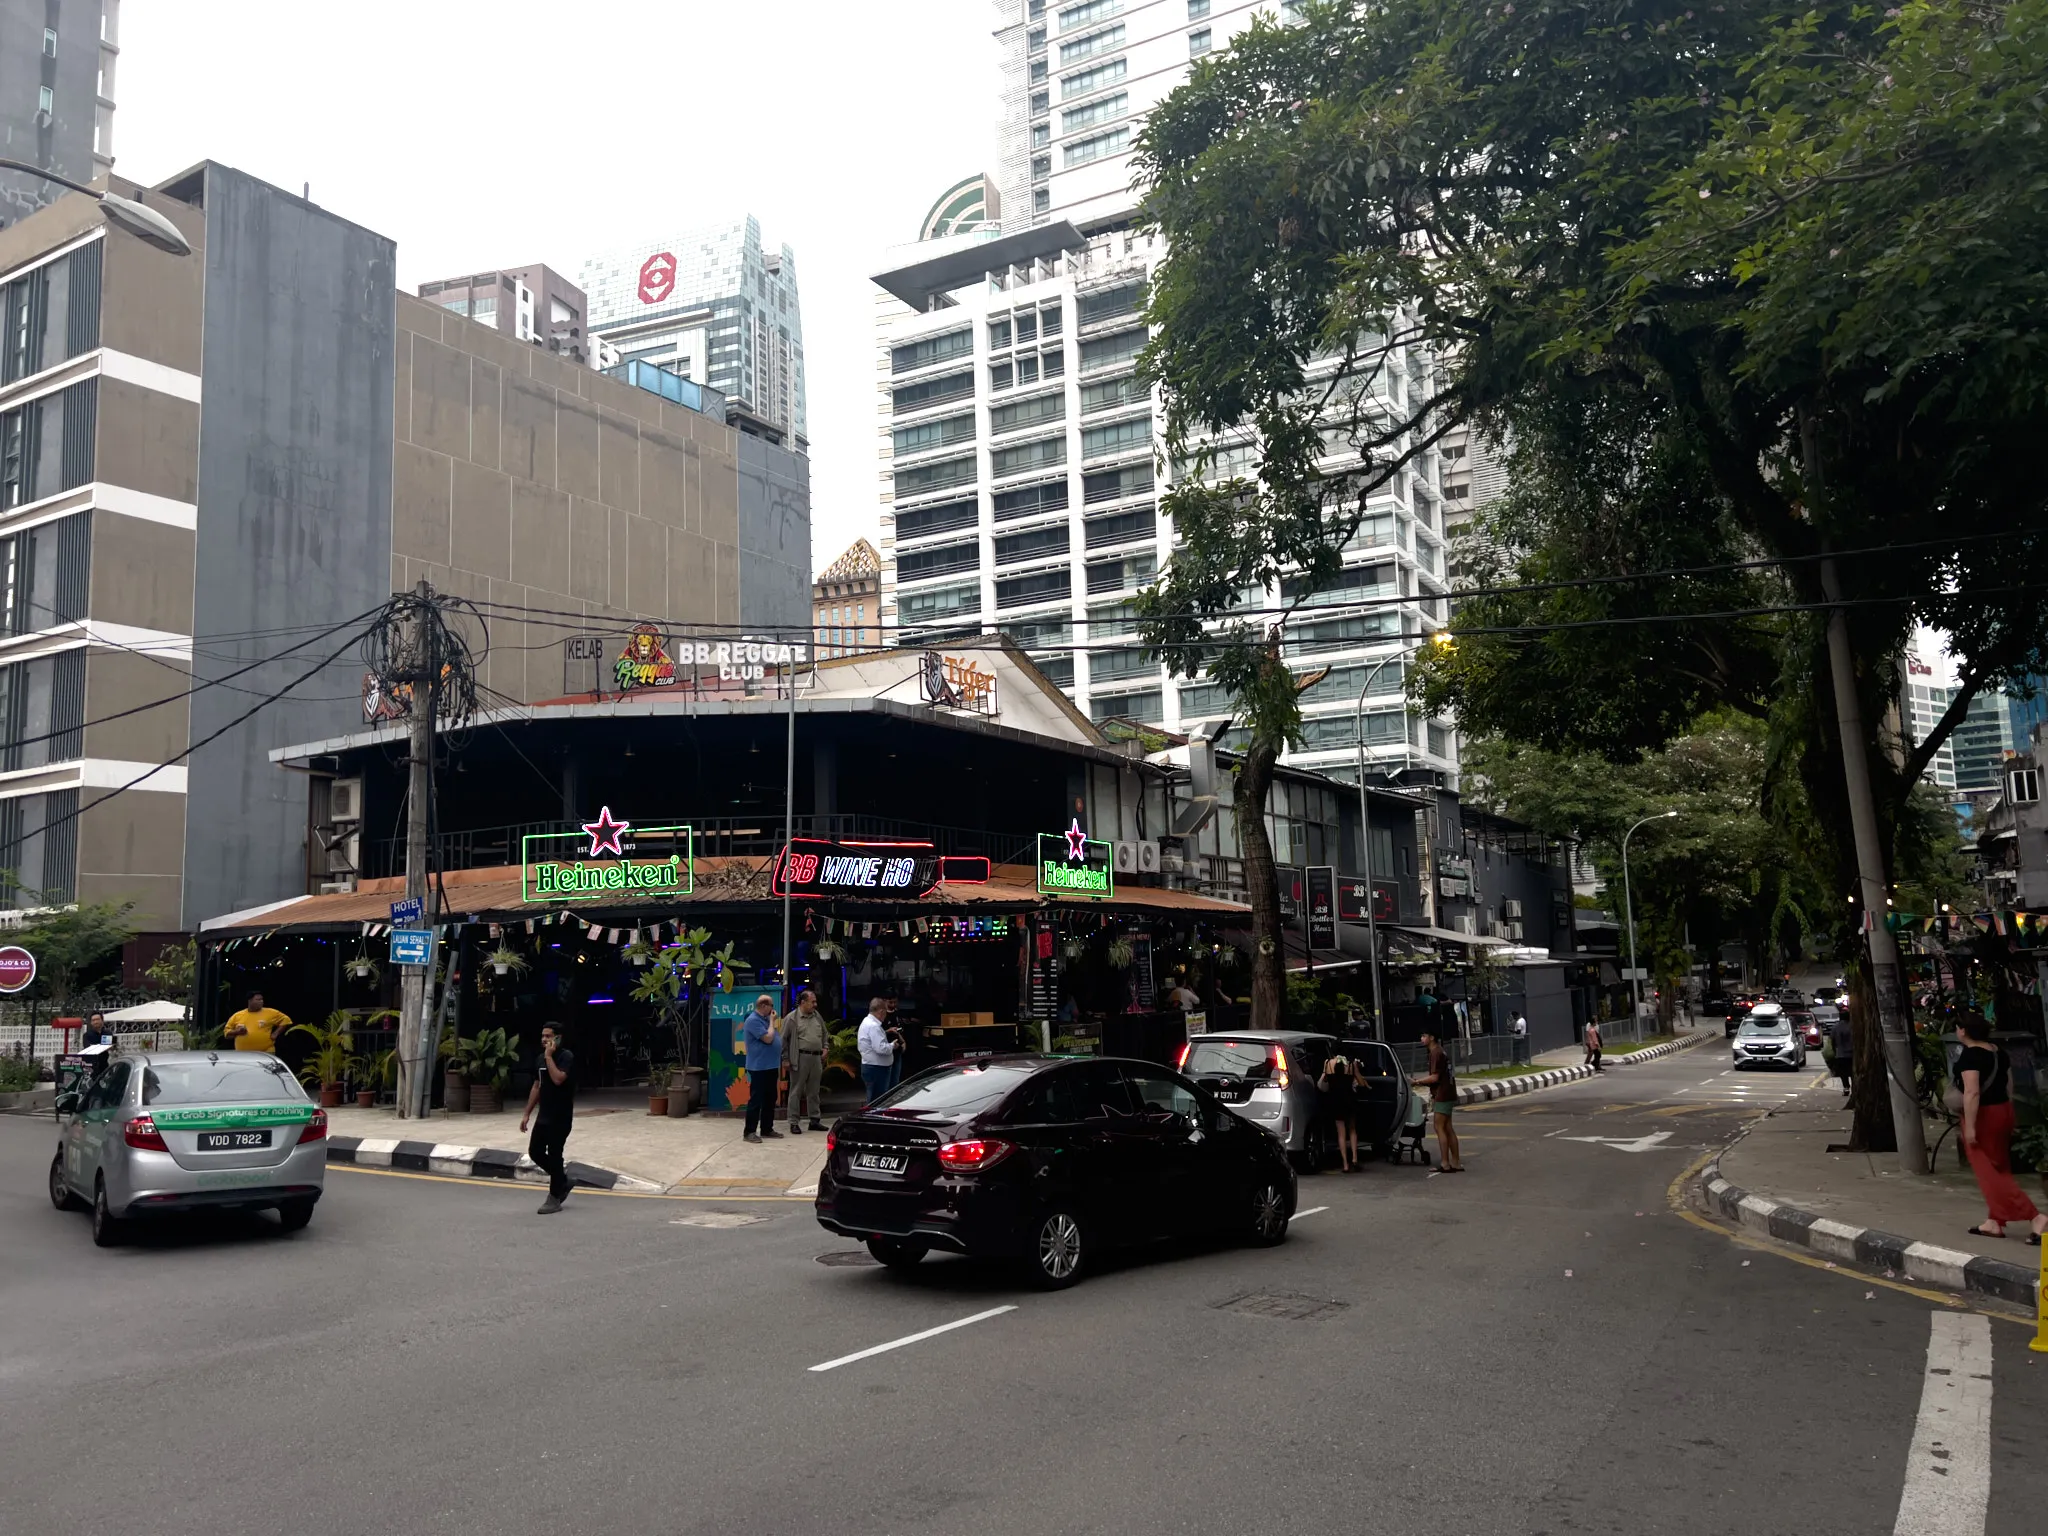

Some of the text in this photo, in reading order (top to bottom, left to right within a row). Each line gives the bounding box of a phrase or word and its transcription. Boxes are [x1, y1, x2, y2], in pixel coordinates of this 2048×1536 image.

[568, 640, 603, 660] KELAB
[679, 640, 807, 664] BB REGGAE
[616, 659, 674, 688] Reggae
[655, 676, 676, 686] CLUB
[719, 665, 765, 681] CLUB
[945, 656, 994, 701] Tiger
[535, 859, 679, 893] Heineken
[781, 853, 819, 883] BB
[820, 855, 883, 887] WINE
[1044, 860, 1107, 891] Heineken
[393, 898, 420, 913] HOTEL
[165, 1113, 180, 1121] It's
[182, 1111, 206, 1119] Grab
[207, 1109, 259, 1119] Signatures
[272, 1106, 306, 1116] nothing
[209, 1134, 263, 1146] VDD 7822
[862, 1154, 900, 1170] VEE 6714
